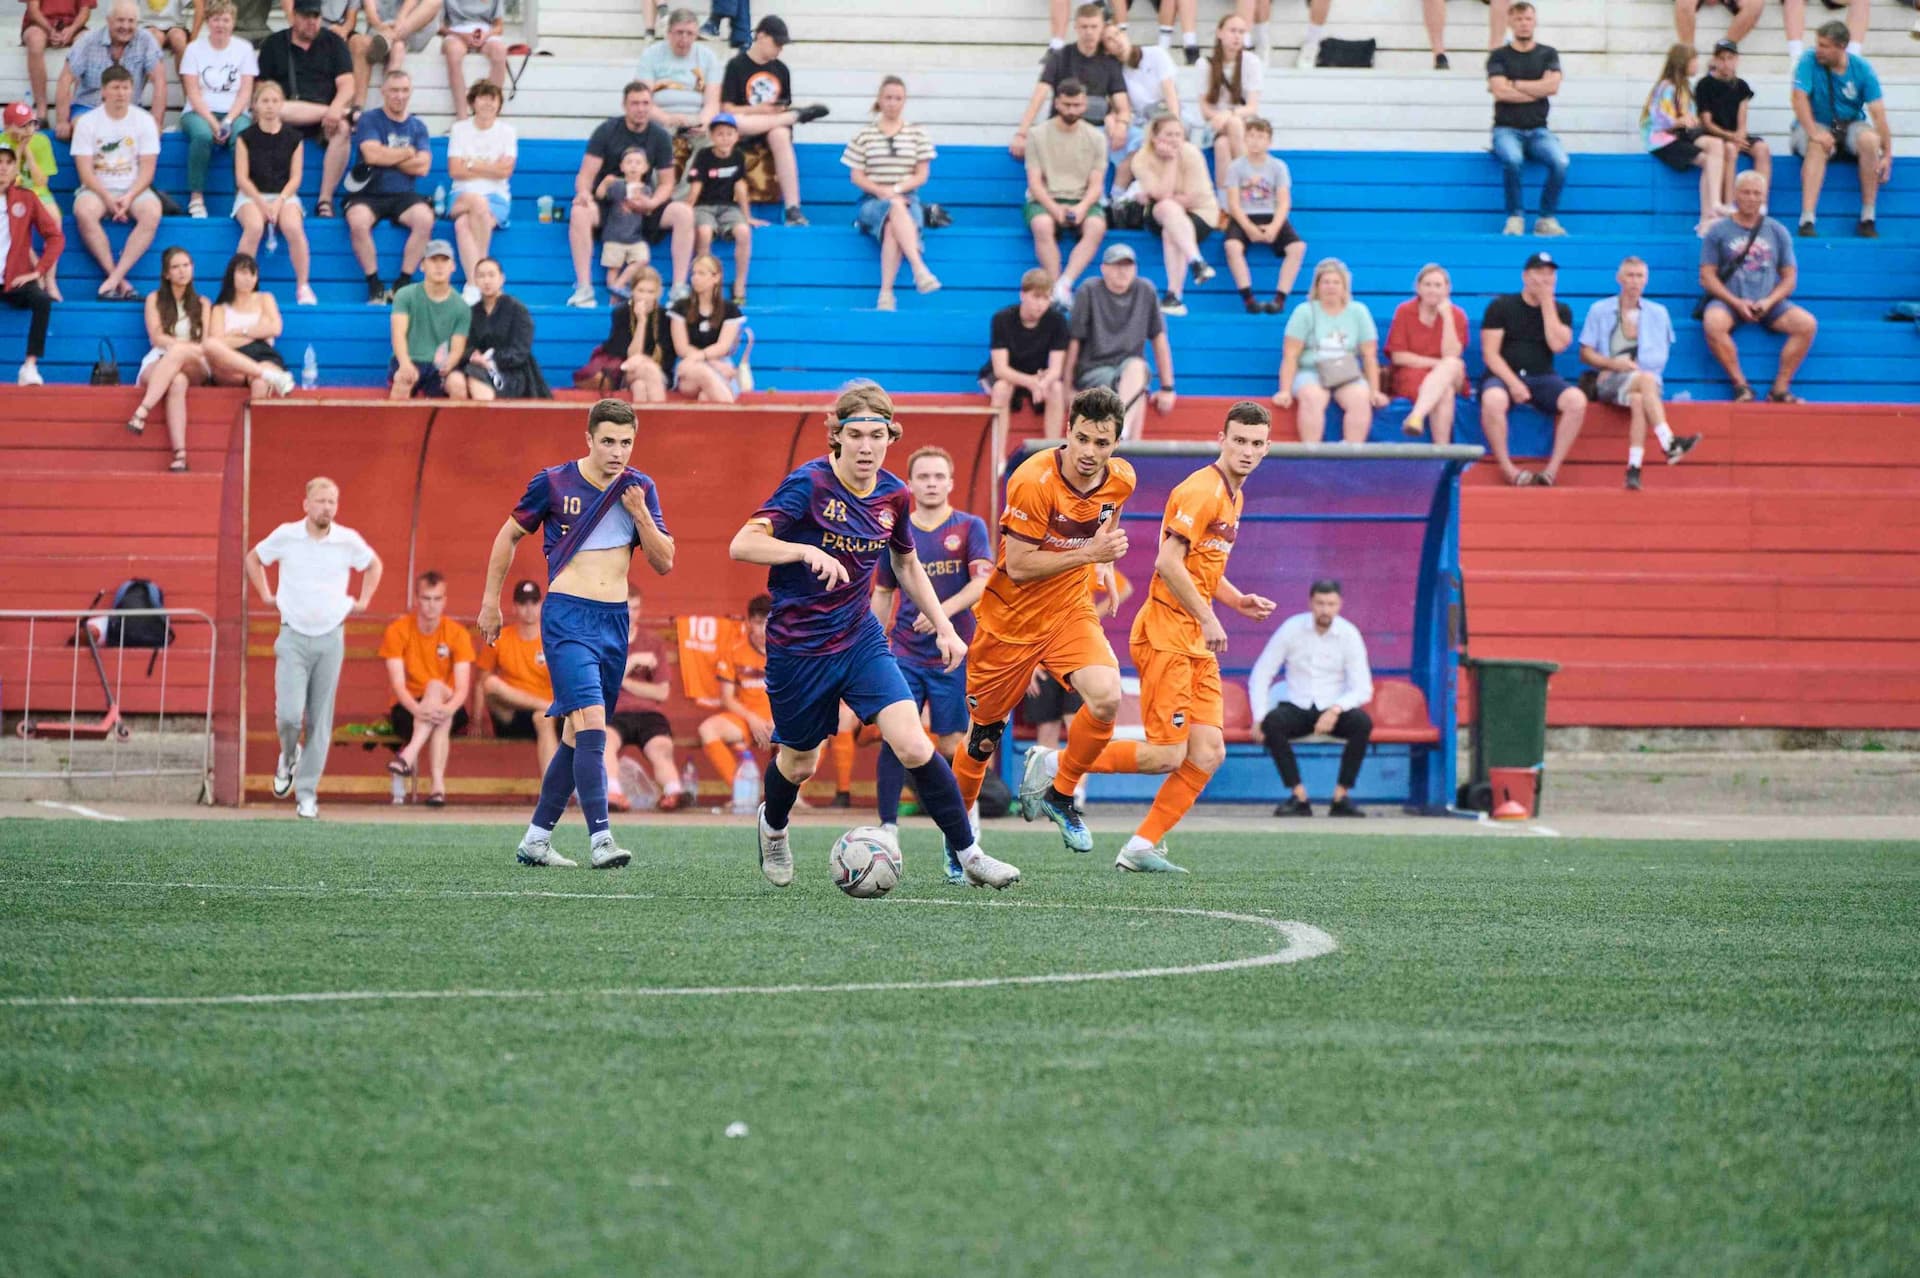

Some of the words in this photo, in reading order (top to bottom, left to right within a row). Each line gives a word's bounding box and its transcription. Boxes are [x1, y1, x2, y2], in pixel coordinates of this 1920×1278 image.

[563, 495, 581, 515] 10
[821, 531, 887, 553] РАССВЕ
[688, 615, 717, 641] 10
